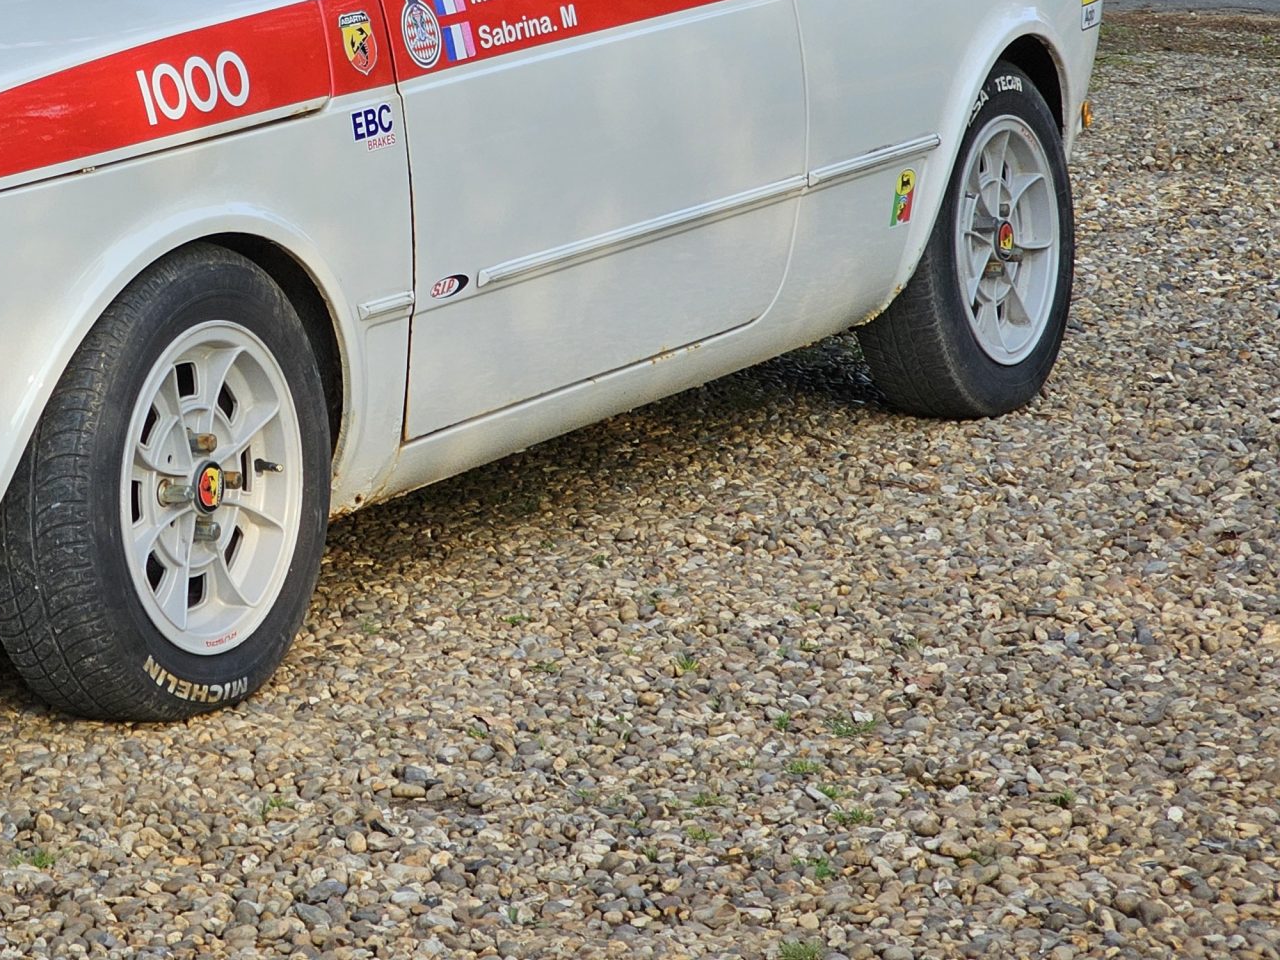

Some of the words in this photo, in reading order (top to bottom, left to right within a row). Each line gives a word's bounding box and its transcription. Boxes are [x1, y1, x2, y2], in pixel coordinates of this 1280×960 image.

[340, 14, 369, 25] ABARTH
[478, 15, 558, 49] Sabrina.
[560, 3, 578, 29] M
[135, 50, 250, 126] 1000
[351, 104, 393, 141] EBC
[367, 133, 396, 151] BRAKES
[142, 654, 248, 703] MICHELIN
